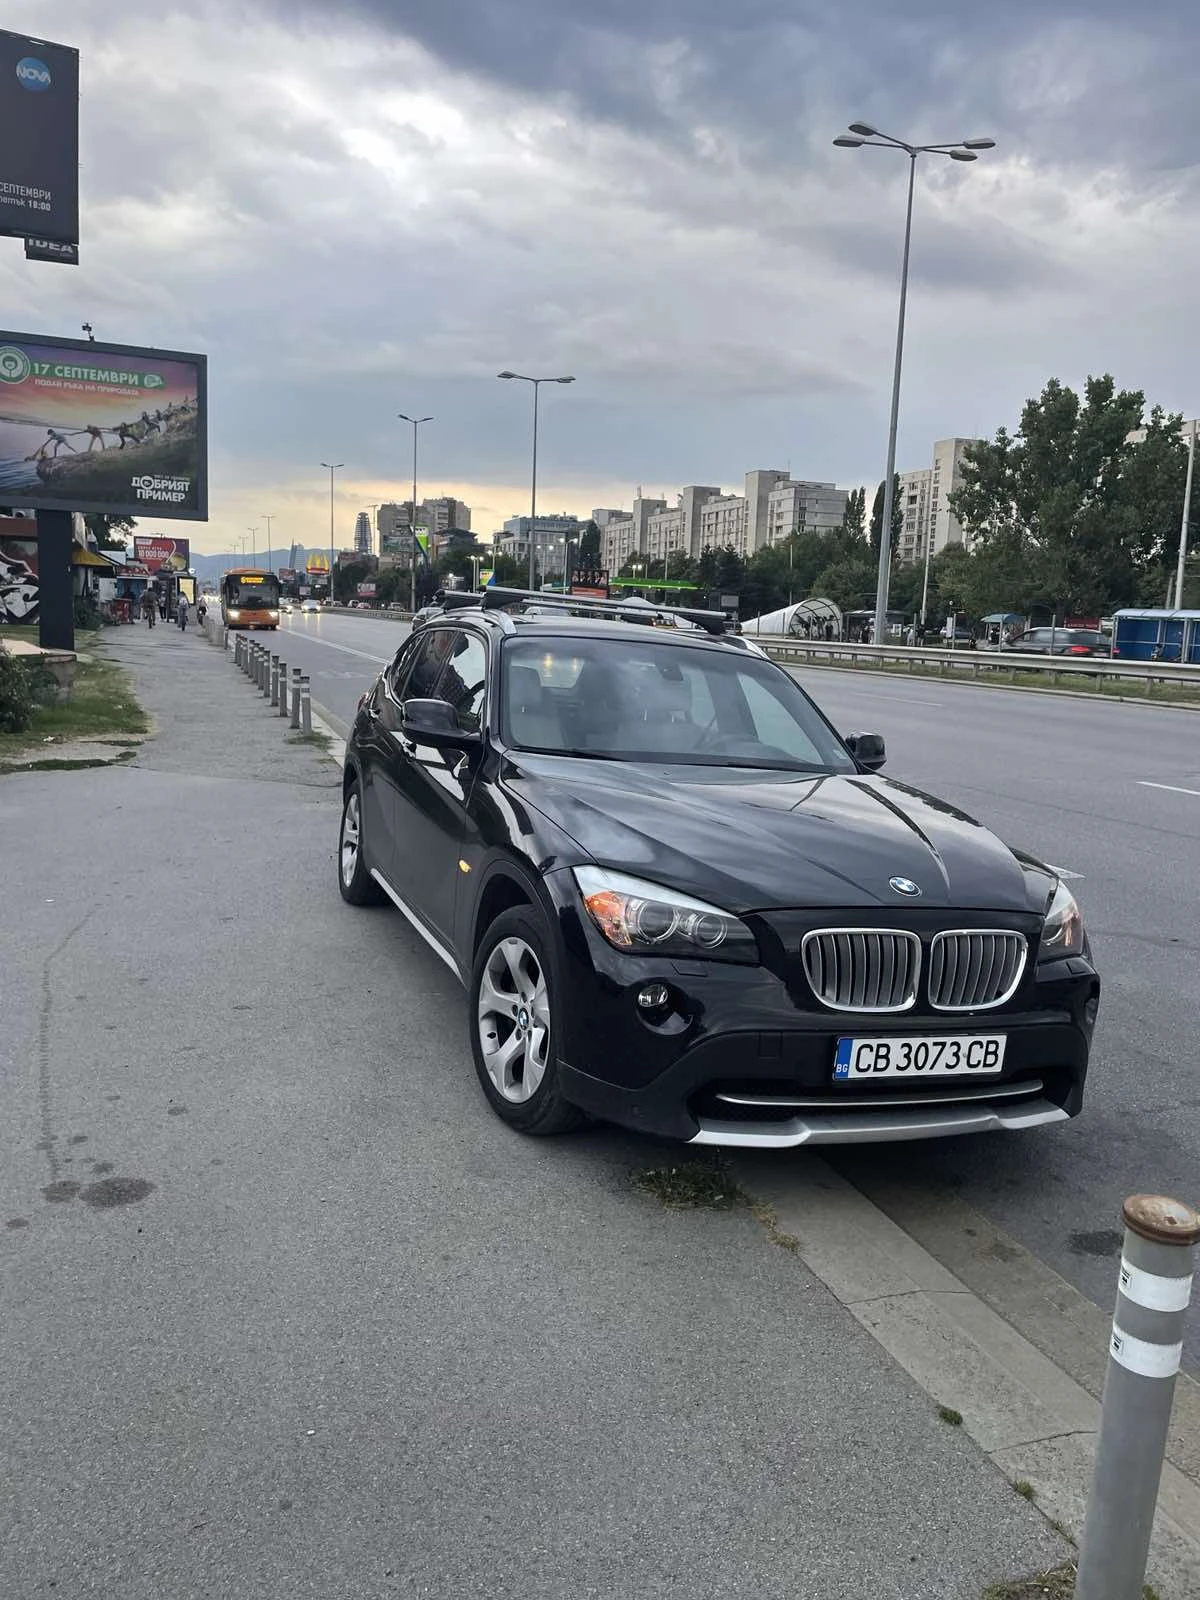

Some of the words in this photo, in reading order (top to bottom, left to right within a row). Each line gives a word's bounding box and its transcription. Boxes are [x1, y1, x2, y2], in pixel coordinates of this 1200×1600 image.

[16, 65, 51, 84] NOVA
[28, 200, 51, 211] 18:00
[33, 363, 50, 375] 17
[54, 366, 138, 386] СЕПТЕМВРИ
[131, 475, 190, 491] ДОБРИЯТ
[136, 489, 185, 503] ПРИМЕР
[855, 1043, 891, 1073] CB
[896, 1040, 961, 1072] 3073
[966, 1039, 999, 1068] CB
[836, 1064, 848, 1073] BG
